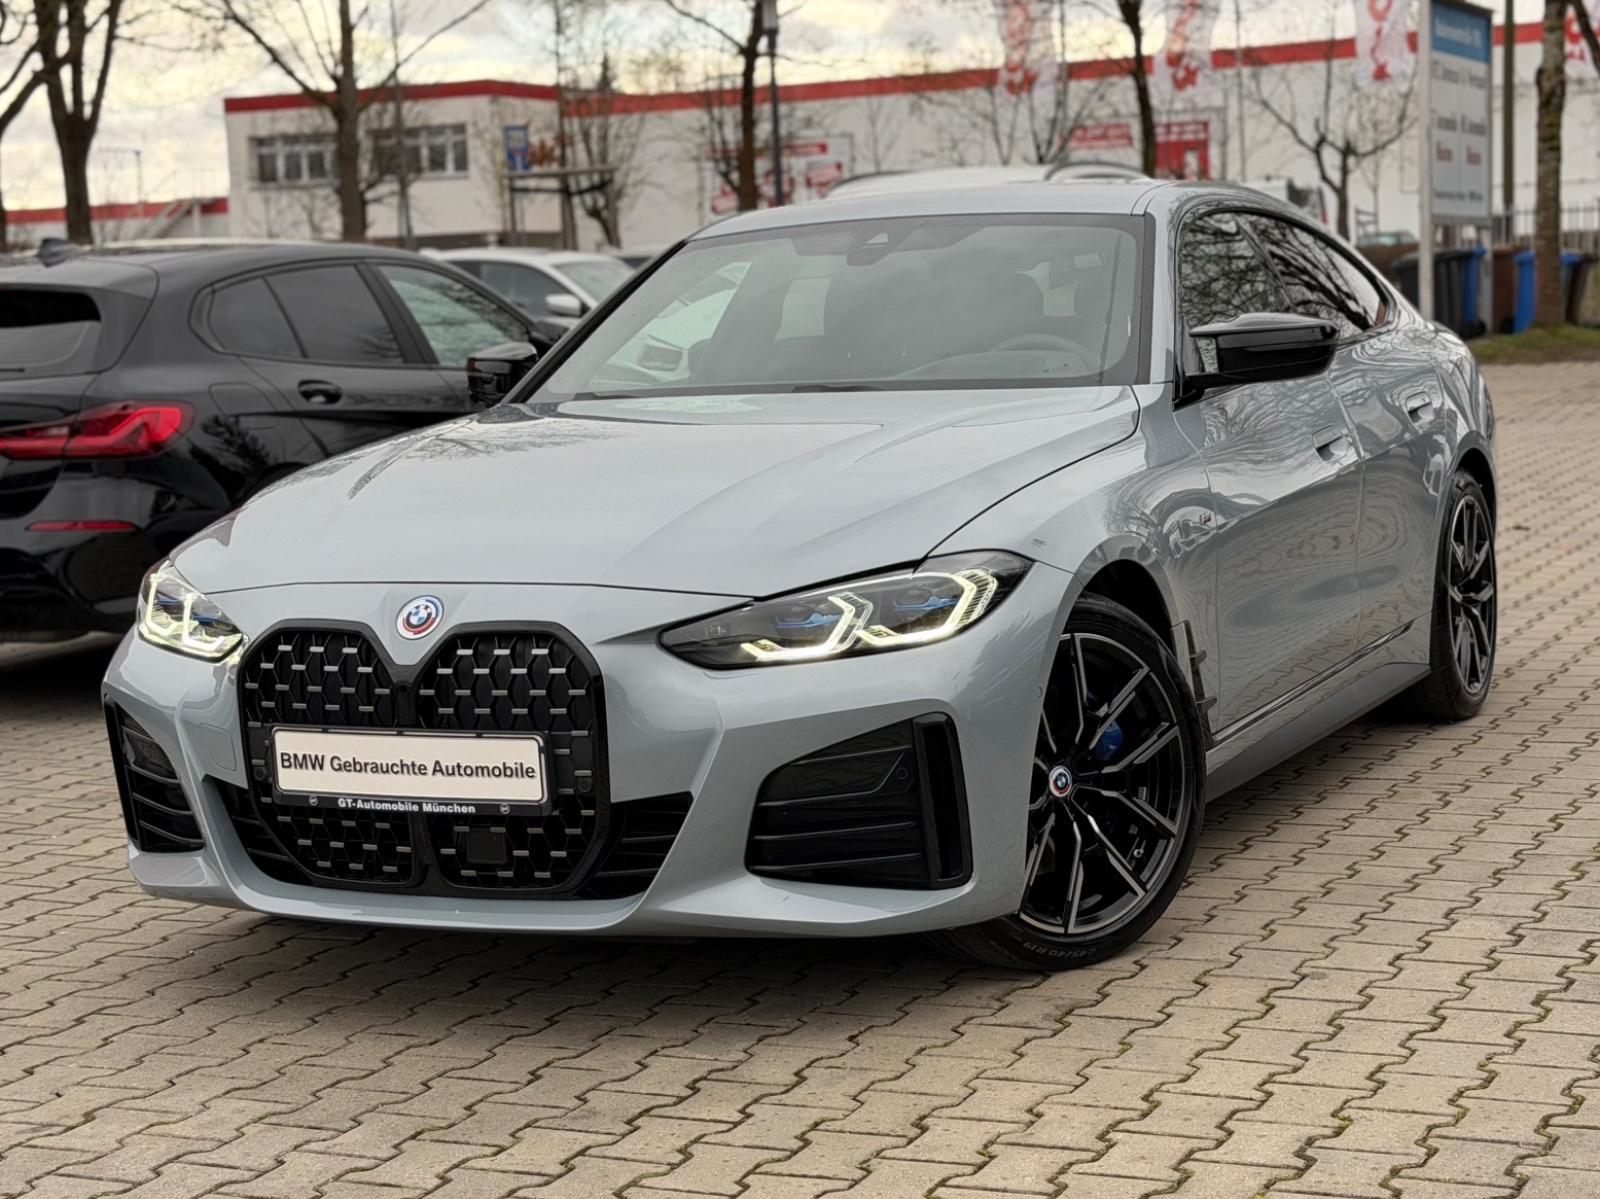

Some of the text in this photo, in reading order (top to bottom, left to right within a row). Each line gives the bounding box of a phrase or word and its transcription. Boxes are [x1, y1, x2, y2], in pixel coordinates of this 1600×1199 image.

[280, 752, 536, 779] BMW Gebrauchte Automobile
[338, 798, 476, 814] GT-Automobile München
